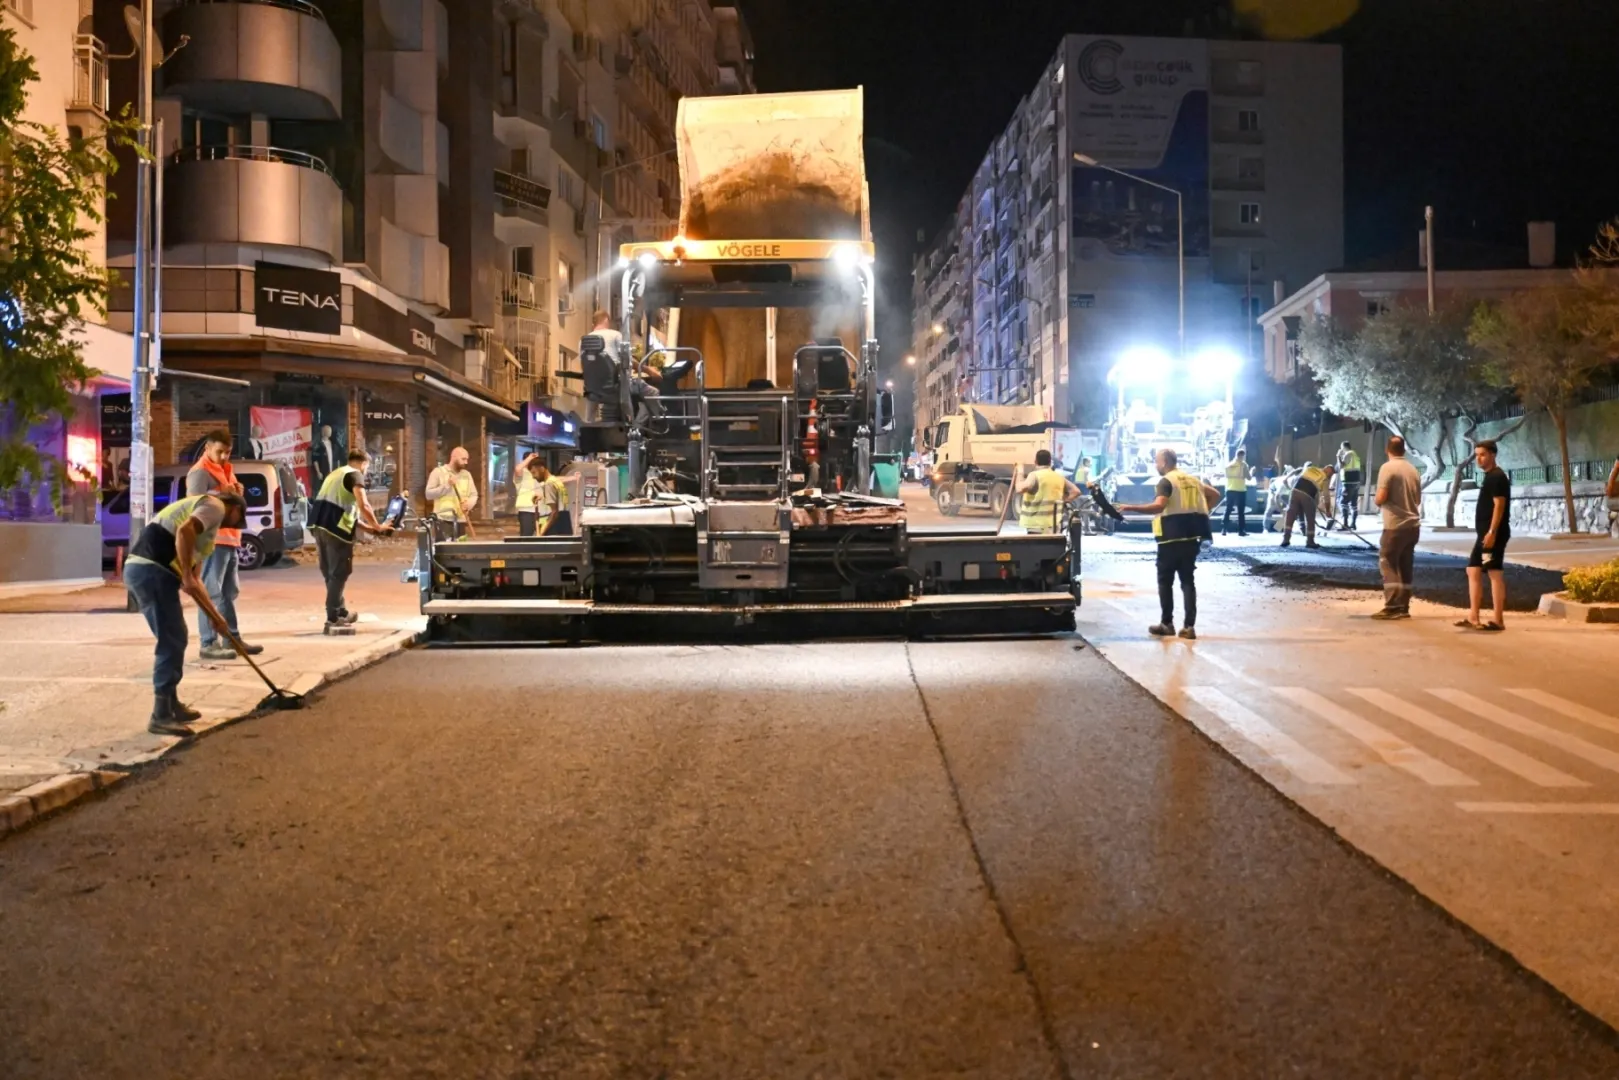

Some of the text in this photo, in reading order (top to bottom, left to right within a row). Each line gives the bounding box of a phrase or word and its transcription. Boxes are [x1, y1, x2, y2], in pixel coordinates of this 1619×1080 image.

[717, 242, 781, 257] VÖGELE
[262, 286, 339, 311] TENA
[100, 405, 132, 414] EN
[365, 412, 404, 420] TENA
